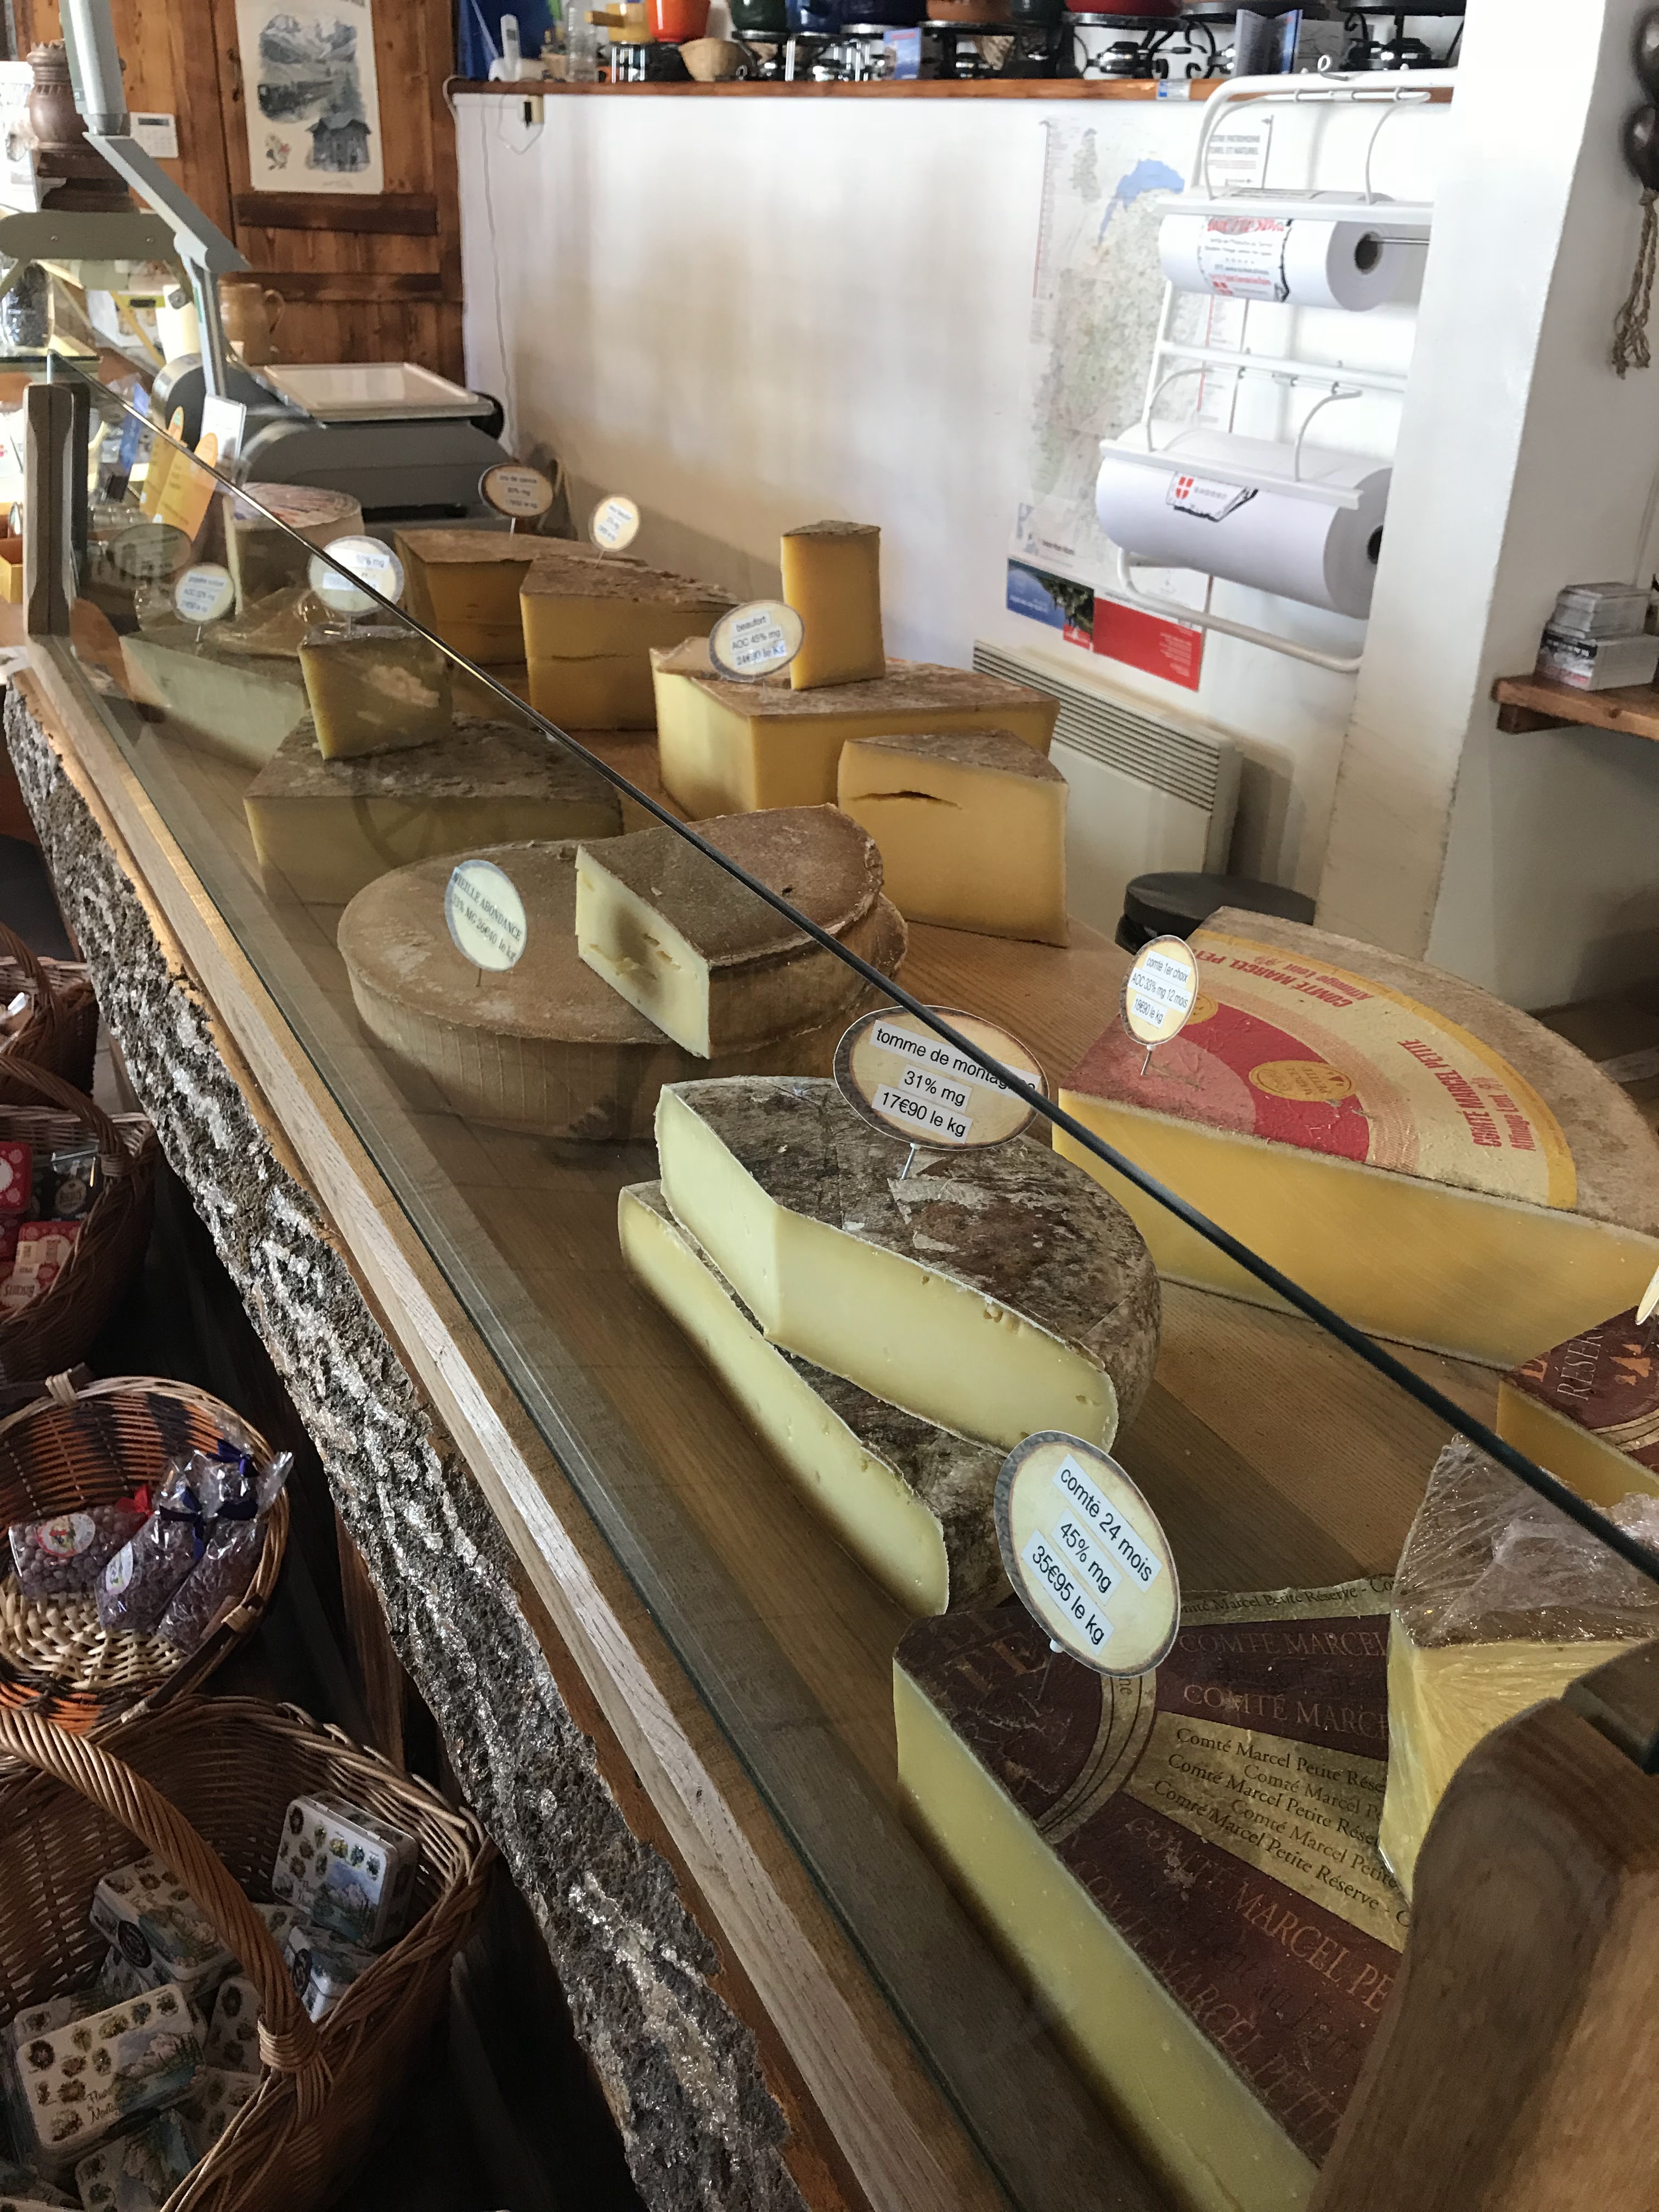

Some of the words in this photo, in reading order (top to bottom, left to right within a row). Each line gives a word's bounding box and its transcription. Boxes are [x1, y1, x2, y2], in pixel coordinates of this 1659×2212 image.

[465, 907, 478, 924] MG
[499, 938, 506, 951] le
[506, 946, 517, 962] kg
[481, 898, 521, 941] ABONDANCE
[1147, 957, 1164, 972] comté
[1165, 962, 1173, 975] 1er
[1173, 968, 1189, 983] choix
[1229, 958, 1298, 986] MARCEL
[1283, 963, 1317, 978] Lent
[1316, 974, 1375, 1001] Affinage
[1131, 972, 1145, 987] AOC
[1144, 977, 1157, 993] 33%
[1157, 985, 1166, 1000] mg
[1167, 988, 1175, 1002] 12
[1174, 994, 1189, 1009] mois
[1133, 997, 1150, 1017] 18€90
[1149, 1006, 1156, 1017] le
[1155, 1009, 1164, 1025] kg
[876, 1028, 927, 1057] tomme
[930, 1047, 950, 1065] de
[1397, 1039, 1451, 1069] PETITE
[904, 1070, 938, 1095] 31%
[940, 1085, 966, 1107] mg
[1434, 1070, 1486, 1109] MARCEL
[1487, 1093, 1520, 1113] Lent
[881, 1092, 928, 1121] 17€90
[930, 1107, 944, 1126] le
[946, 1113, 967, 1137] kg
[1554, 1328, 1604, 1401] RÉSER
[1060, 1469, 1101, 1517] comté
[1099, 1513, 1122, 1541] 24
[1118, 1537, 1153, 1582] mois
[1060, 1522, 1088, 1563] 45%
[1088, 1561, 1112, 1594] mg
[1032, 1544, 1075, 1601] 35€95
[1071, 1596, 1086, 1619] le
[1085, 1613, 1105, 1645] kg
[1211, 1595, 1262, 1611] Marcel
[1306, 1584, 1359, 1604] Réserve
[1285, 1629, 1387, 1657] MARCEL
[1183, 1684, 1288, 1722] COMTÉ
[1176, 1728, 1232, 1752] Comté
[1235, 1741, 1290, 1768] Marcel
[1296, 1757, 1342, 1781] Petite
[1169, 1753, 1222, 1784] Comté
[1224, 1775, 1283, 1807] Marcel
[1285, 1797, 1331, 1828] Petite
[1244, 1764, 1300, 1793] Comté
[1304, 1784, 1361, 1814] Marcel
[1154, 1780, 1207, 1816] Comté
[1208, 1808, 1266, 1847] Marcel
[1266, 1837, 1313, 1874] Petite
[1314, 1864, 1380, 1910] Réserve
[1231, 1799, 1287, 1833] Comté
[1289, 1826, 1348, 1863] Marcel
[1351, 1853, 1400, 1889] Petite
[1231, 1880, 1352, 1984] MARCEL
